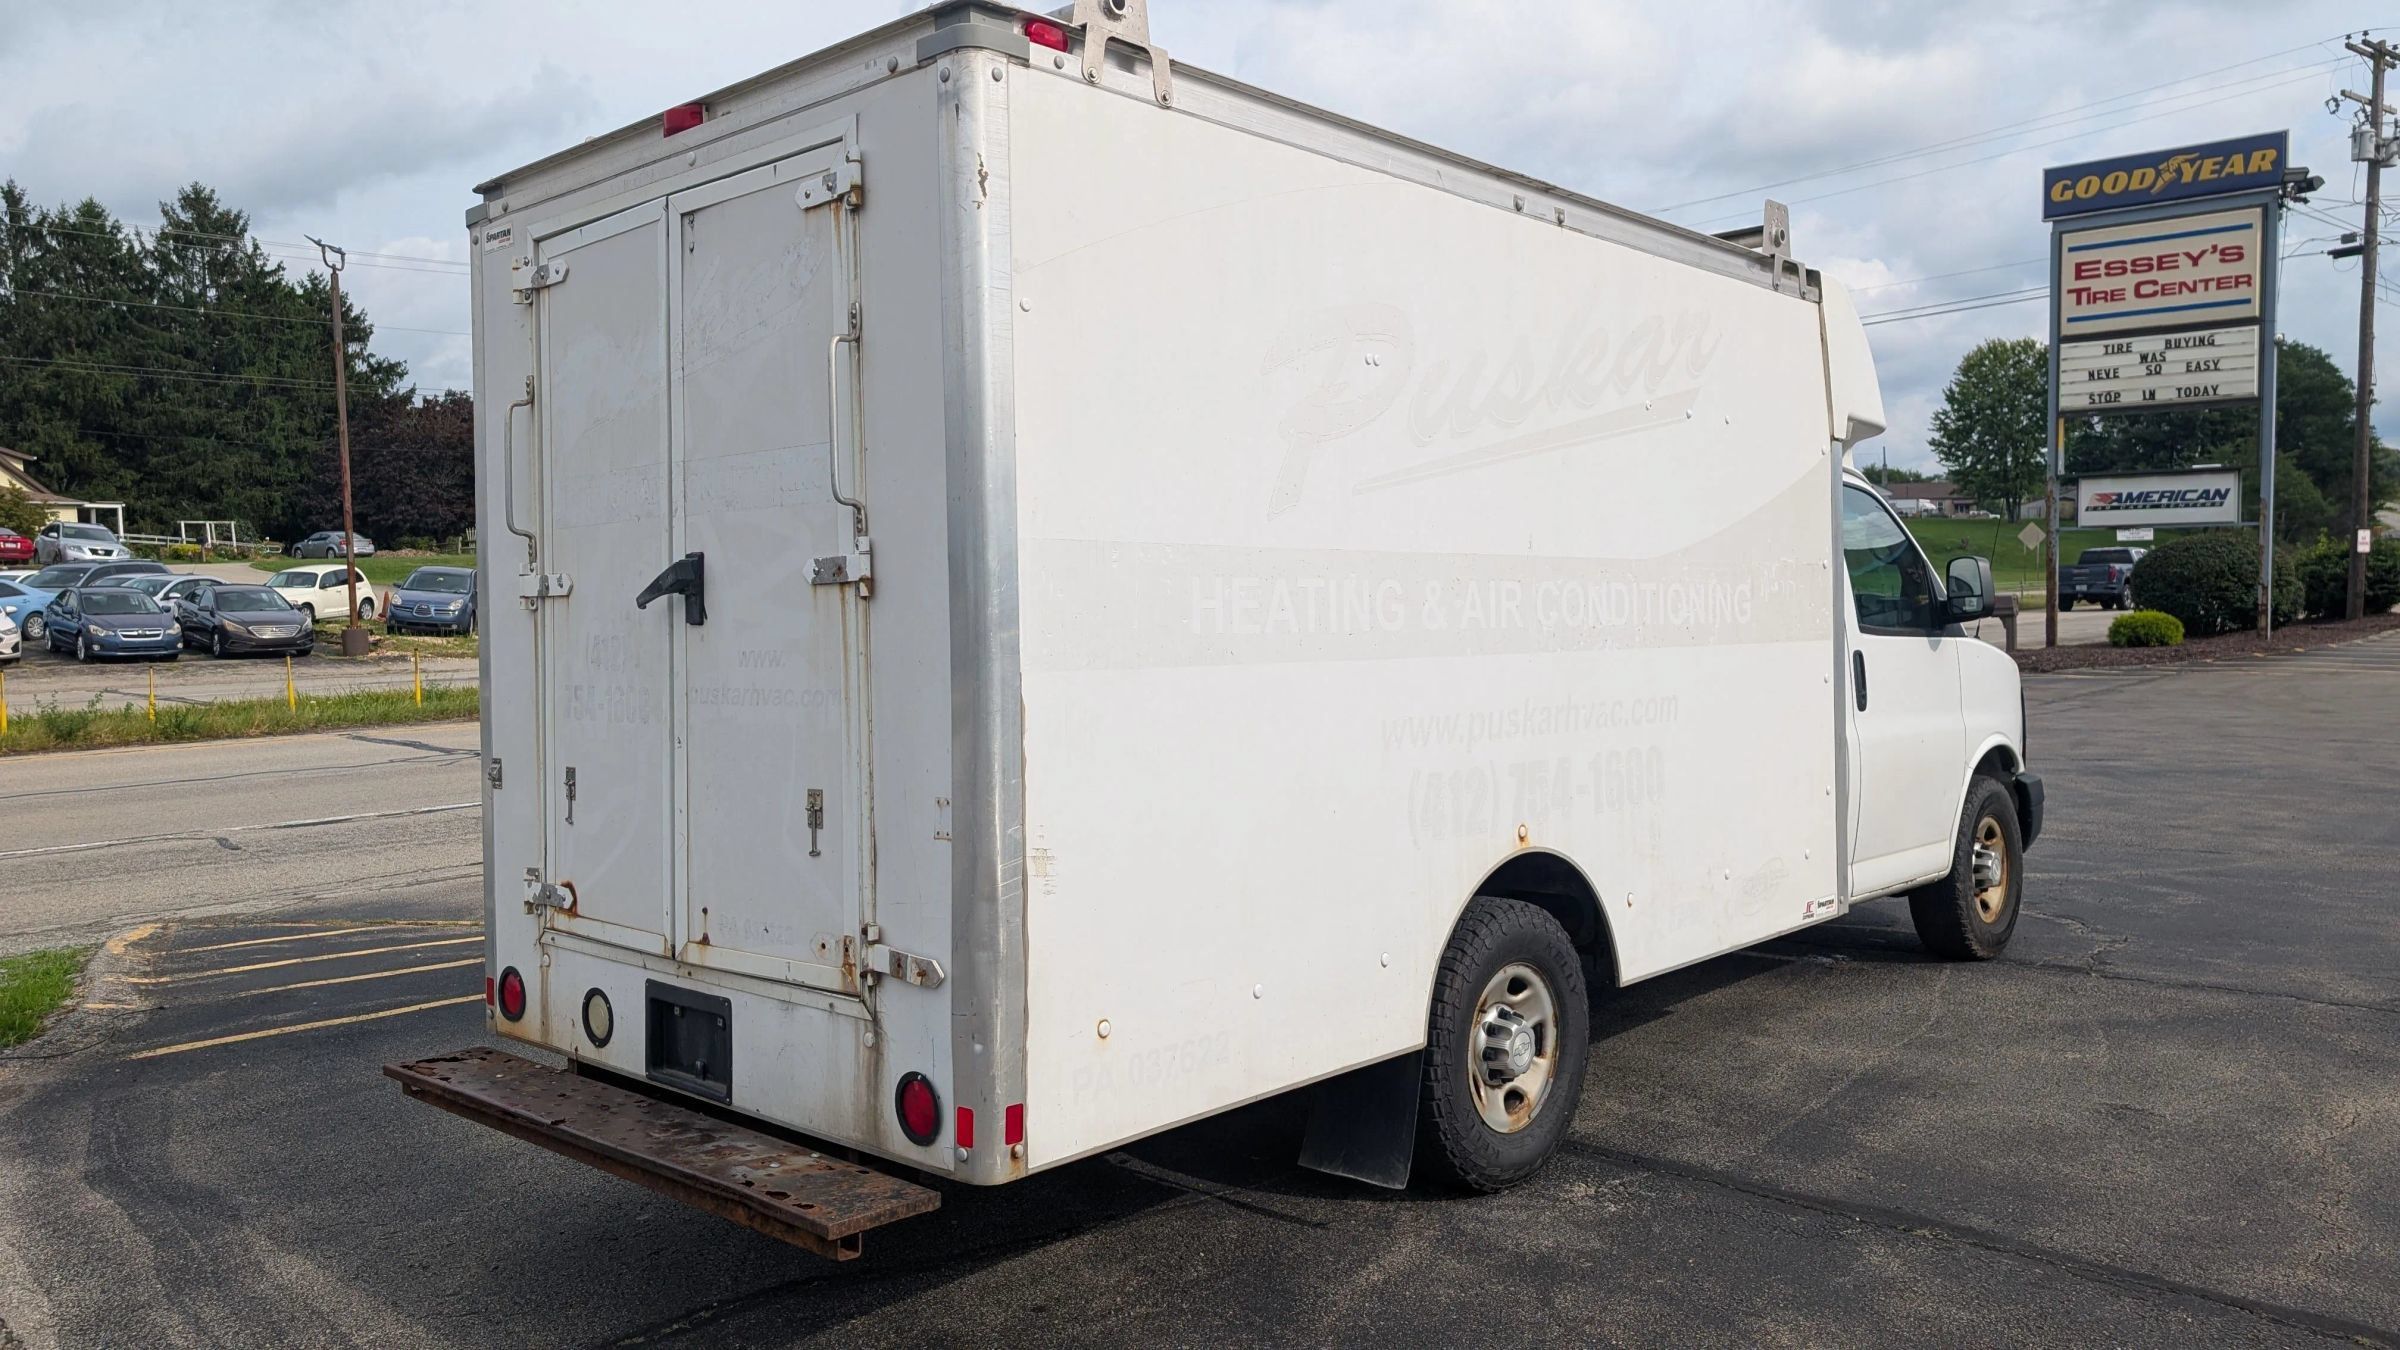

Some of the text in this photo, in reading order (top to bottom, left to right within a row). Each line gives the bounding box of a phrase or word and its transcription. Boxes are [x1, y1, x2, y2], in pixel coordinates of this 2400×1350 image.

[2051, 149, 2278, 202] GOODYEAR
[2074, 244, 2245, 281] ESSEY'S
[2067, 274, 2253, 306] TIRE CENTER
[2103, 335, 2216, 355] TIRE BUYING
[2139, 351, 2166, 363] WAS
[2088, 359, 2220, 381] NEVE SO EASY
[2089, 384, 2219, 405] STOP IN TODAY
[2111, 488, 2231, 504] AMERICAN
[1191, 575, 1751, 635] HEATING & AIR CONDITIONING
[1381, 693, 1679, 754] www.puskarhvac.com
